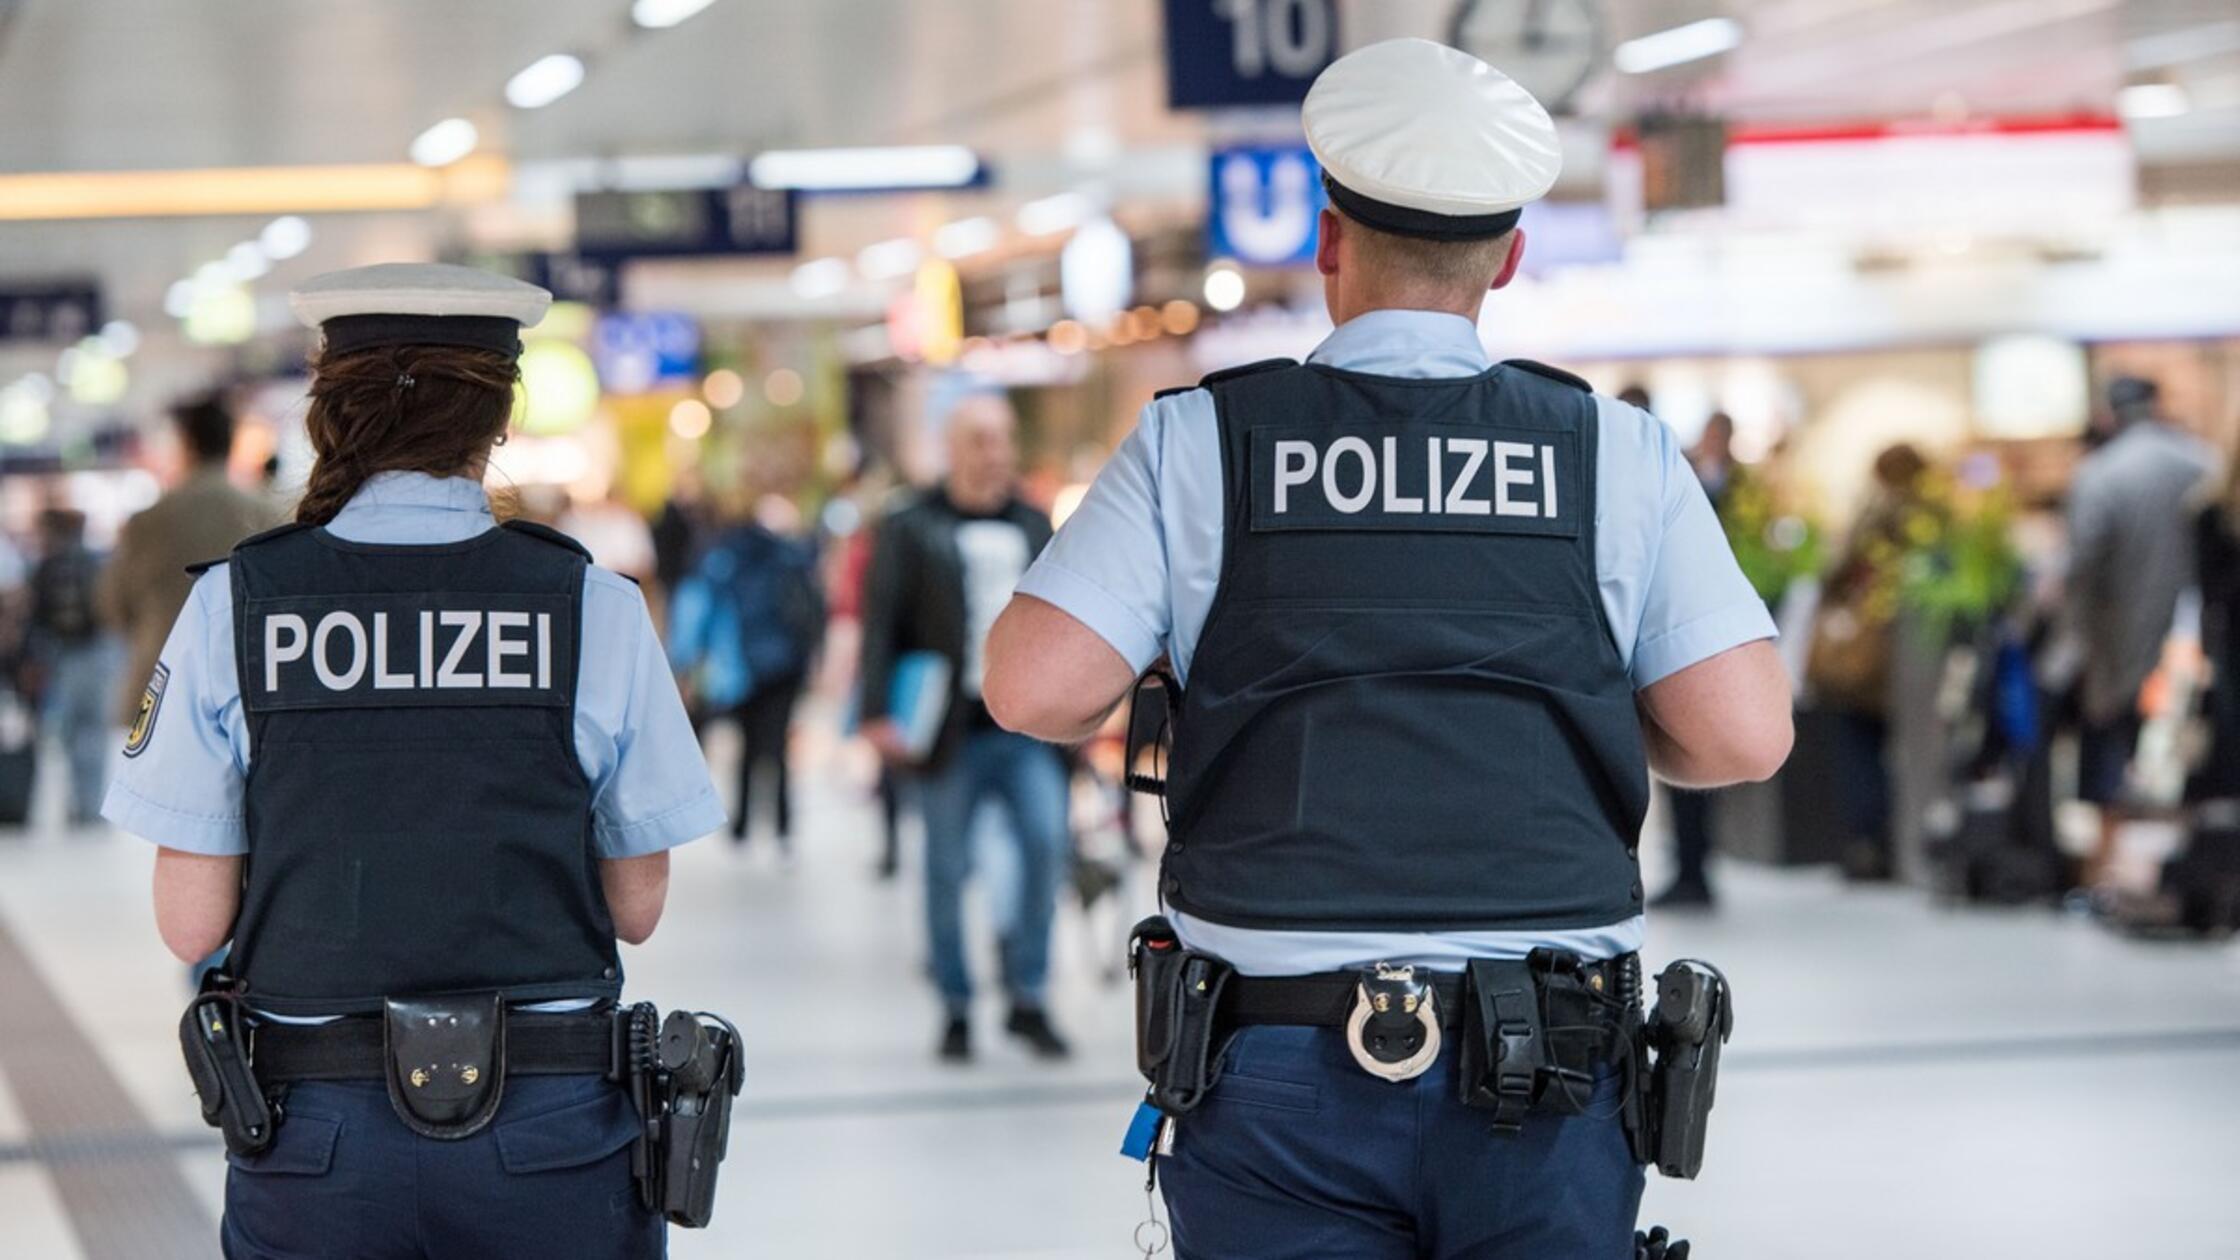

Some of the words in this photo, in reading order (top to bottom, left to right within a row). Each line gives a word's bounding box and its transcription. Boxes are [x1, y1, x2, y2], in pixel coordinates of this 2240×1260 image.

[1213, 0, 1331, 77] 10
[1221, 154, 1312, 262] U
[1274, 436, 1557, 518] POLIZEI
[265, 611, 551, 691] POLIZEI
